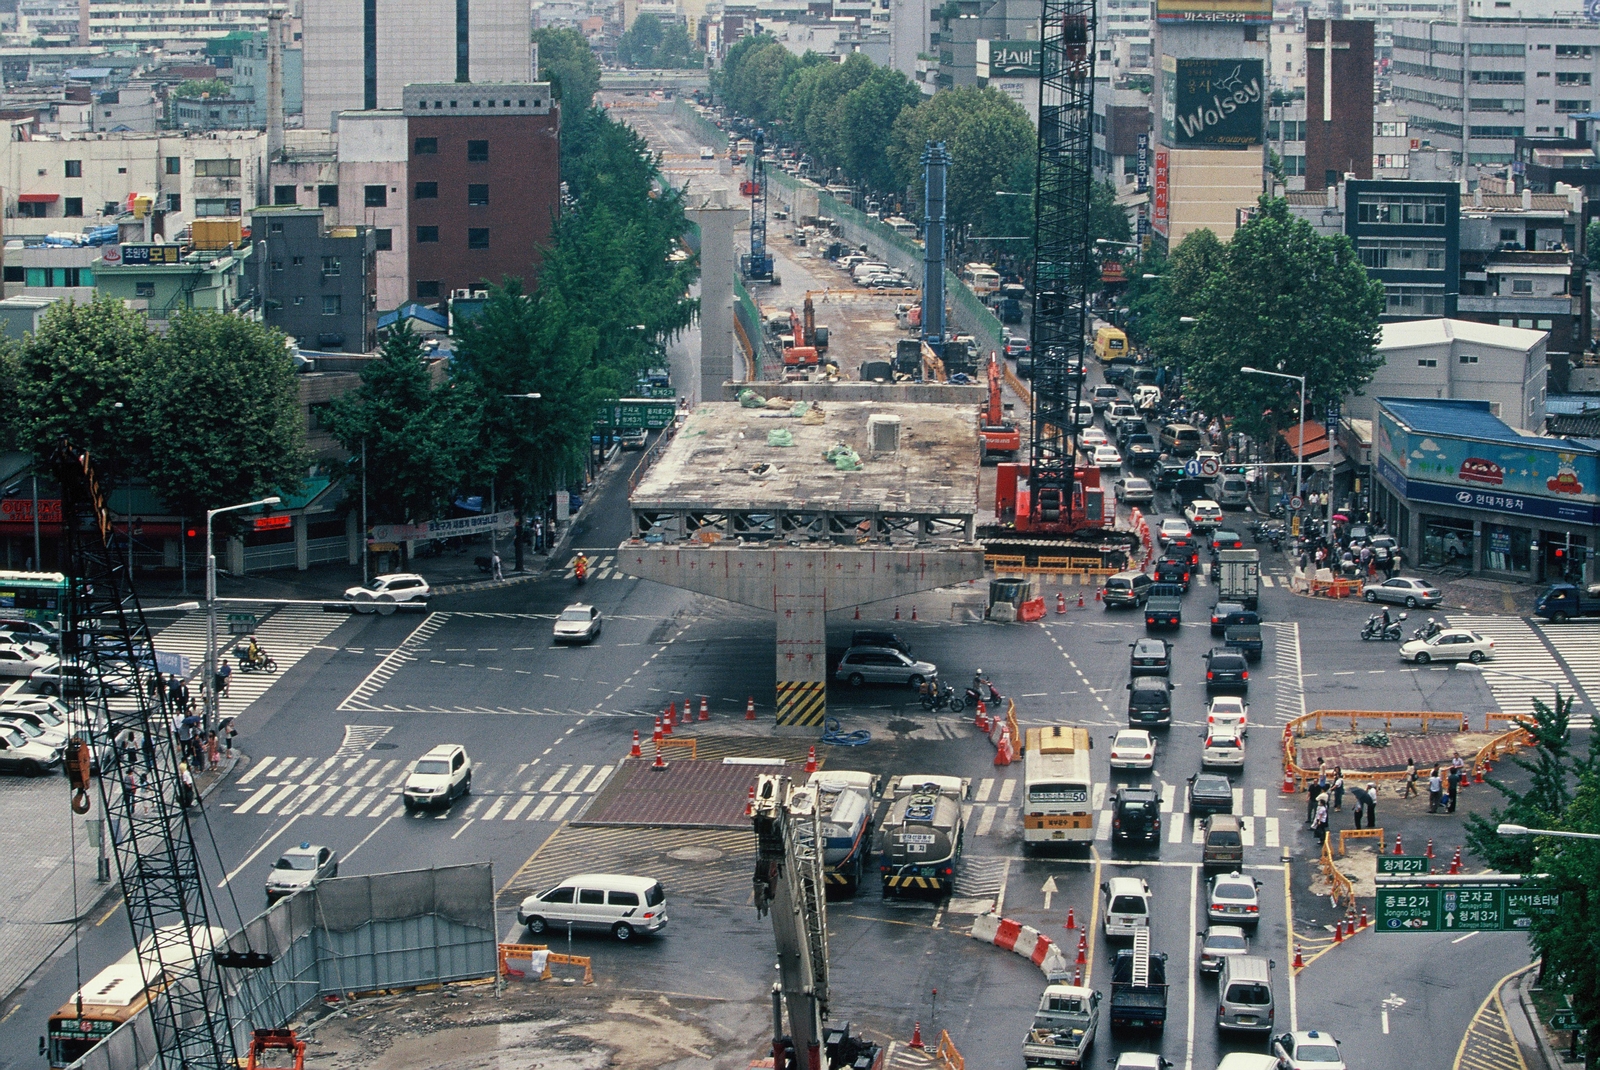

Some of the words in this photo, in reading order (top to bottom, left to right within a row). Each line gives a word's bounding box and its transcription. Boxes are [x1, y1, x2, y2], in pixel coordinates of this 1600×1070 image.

[1177, 77, 1260, 138] Wolsey
[125, 247, 149, 259] 초원장
[1475, 494, 1524, 510] 현대자동차
[1073, 792, 1086, 801] 50
[1384, 859, 1423, 871] 청계2가
[1384, 895, 1430, 908] 종로2가
[1459, 891, 1493, 903] 군자교
[1384, 909, 1409, 918] Jongno
[1459, 910, 1498, 921] 청계3가
